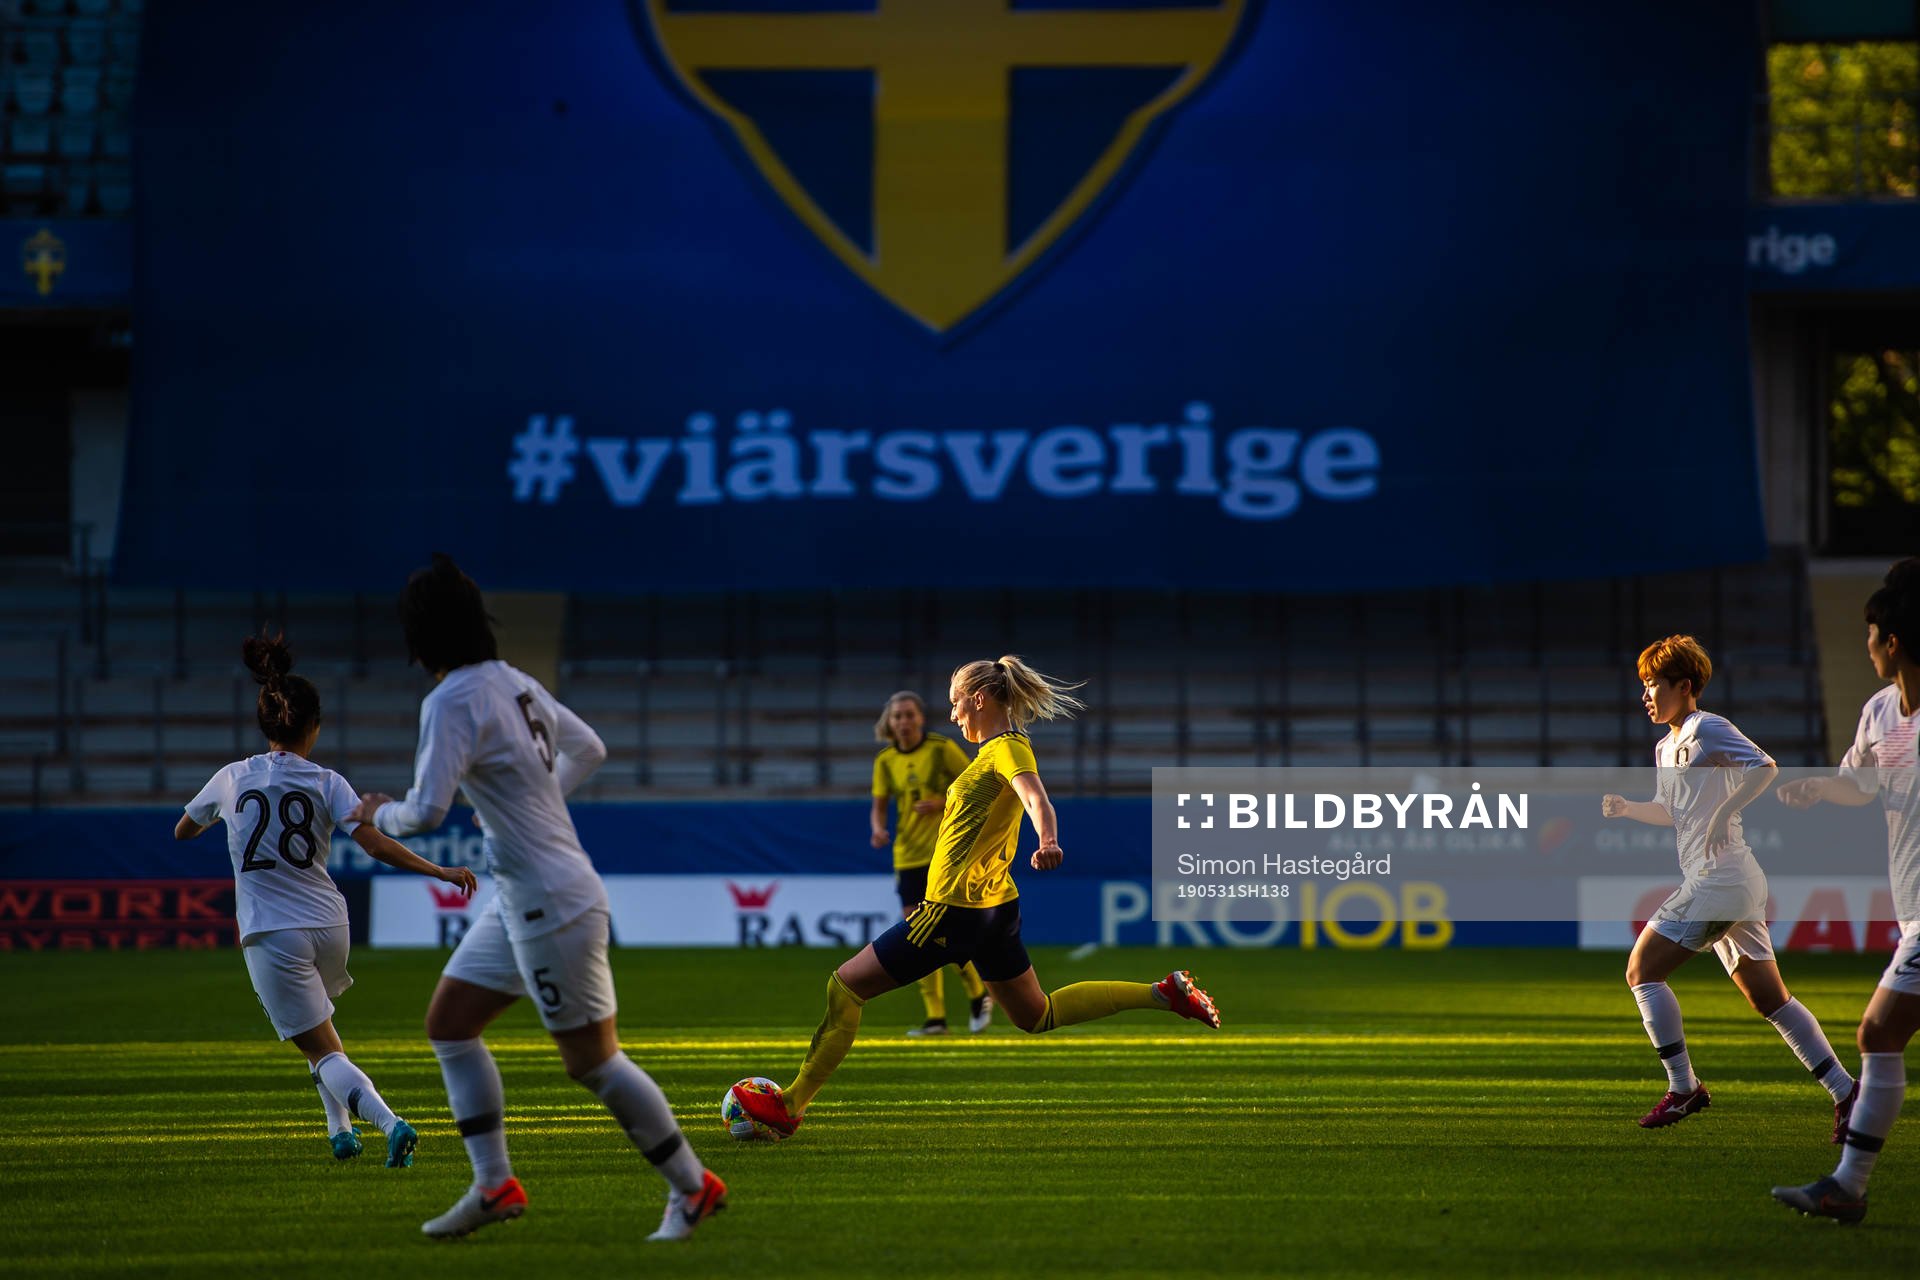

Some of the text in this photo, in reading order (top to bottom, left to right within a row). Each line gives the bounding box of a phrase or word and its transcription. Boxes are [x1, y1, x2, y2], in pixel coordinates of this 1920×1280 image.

[508, 402, 1381, 520] #viärsverige
[515, 694, 554, 773] 5
[235, 789, 316, 872] 28
[0, 886, 227, 922] WORK
[533, 967, 562, 1007] 5
